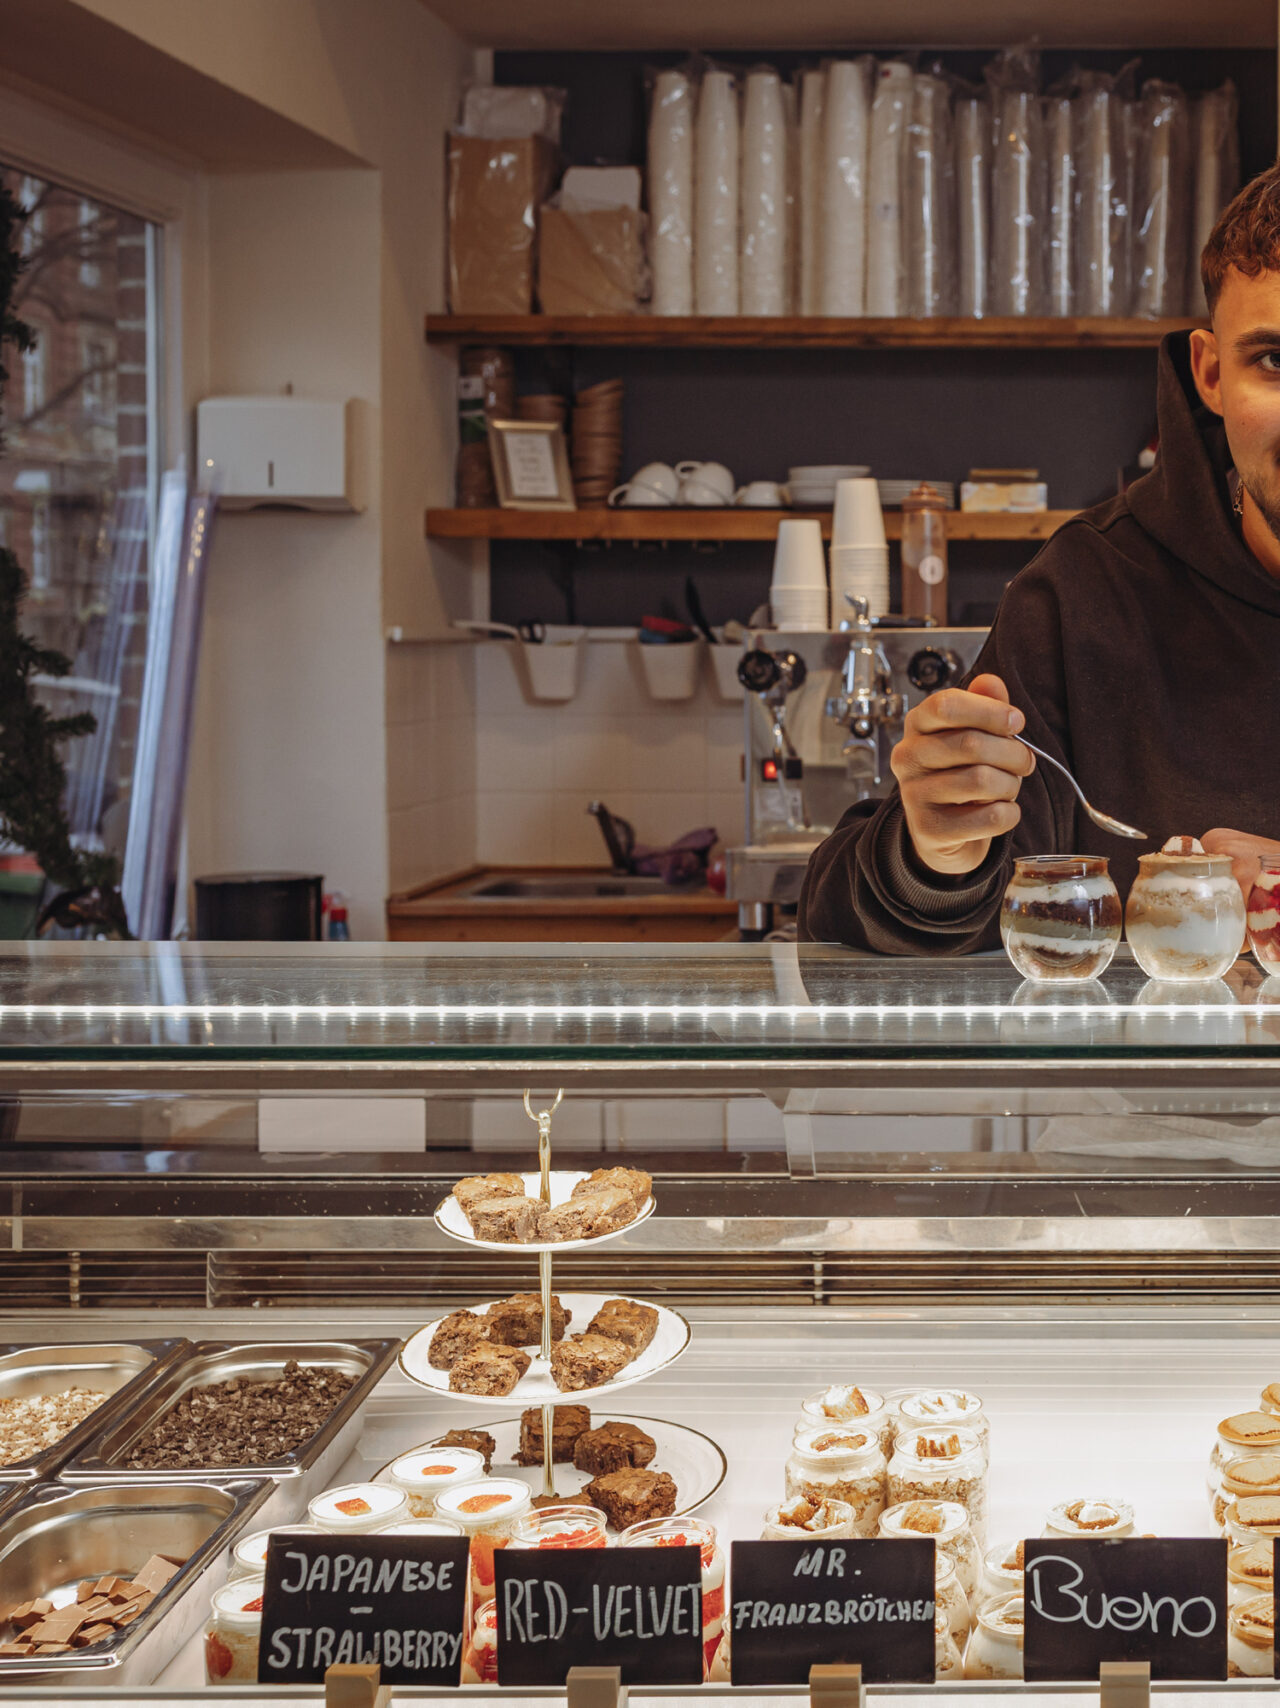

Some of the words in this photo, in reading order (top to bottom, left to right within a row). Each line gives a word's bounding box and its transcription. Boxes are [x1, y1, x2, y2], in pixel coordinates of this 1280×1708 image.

[280, 1551, 455, 1594] JAPANESE
[793, 1547, 862, 1578] MR.
[504, 1578, 701, 1643] RED-VELVET
[733, 1593, 936, 1630] FRANZBRÖTCHEN
[1025, 1555, 1217, 1638] Bueno
[267, 1626, 463, 1669] STRAWBERRY
